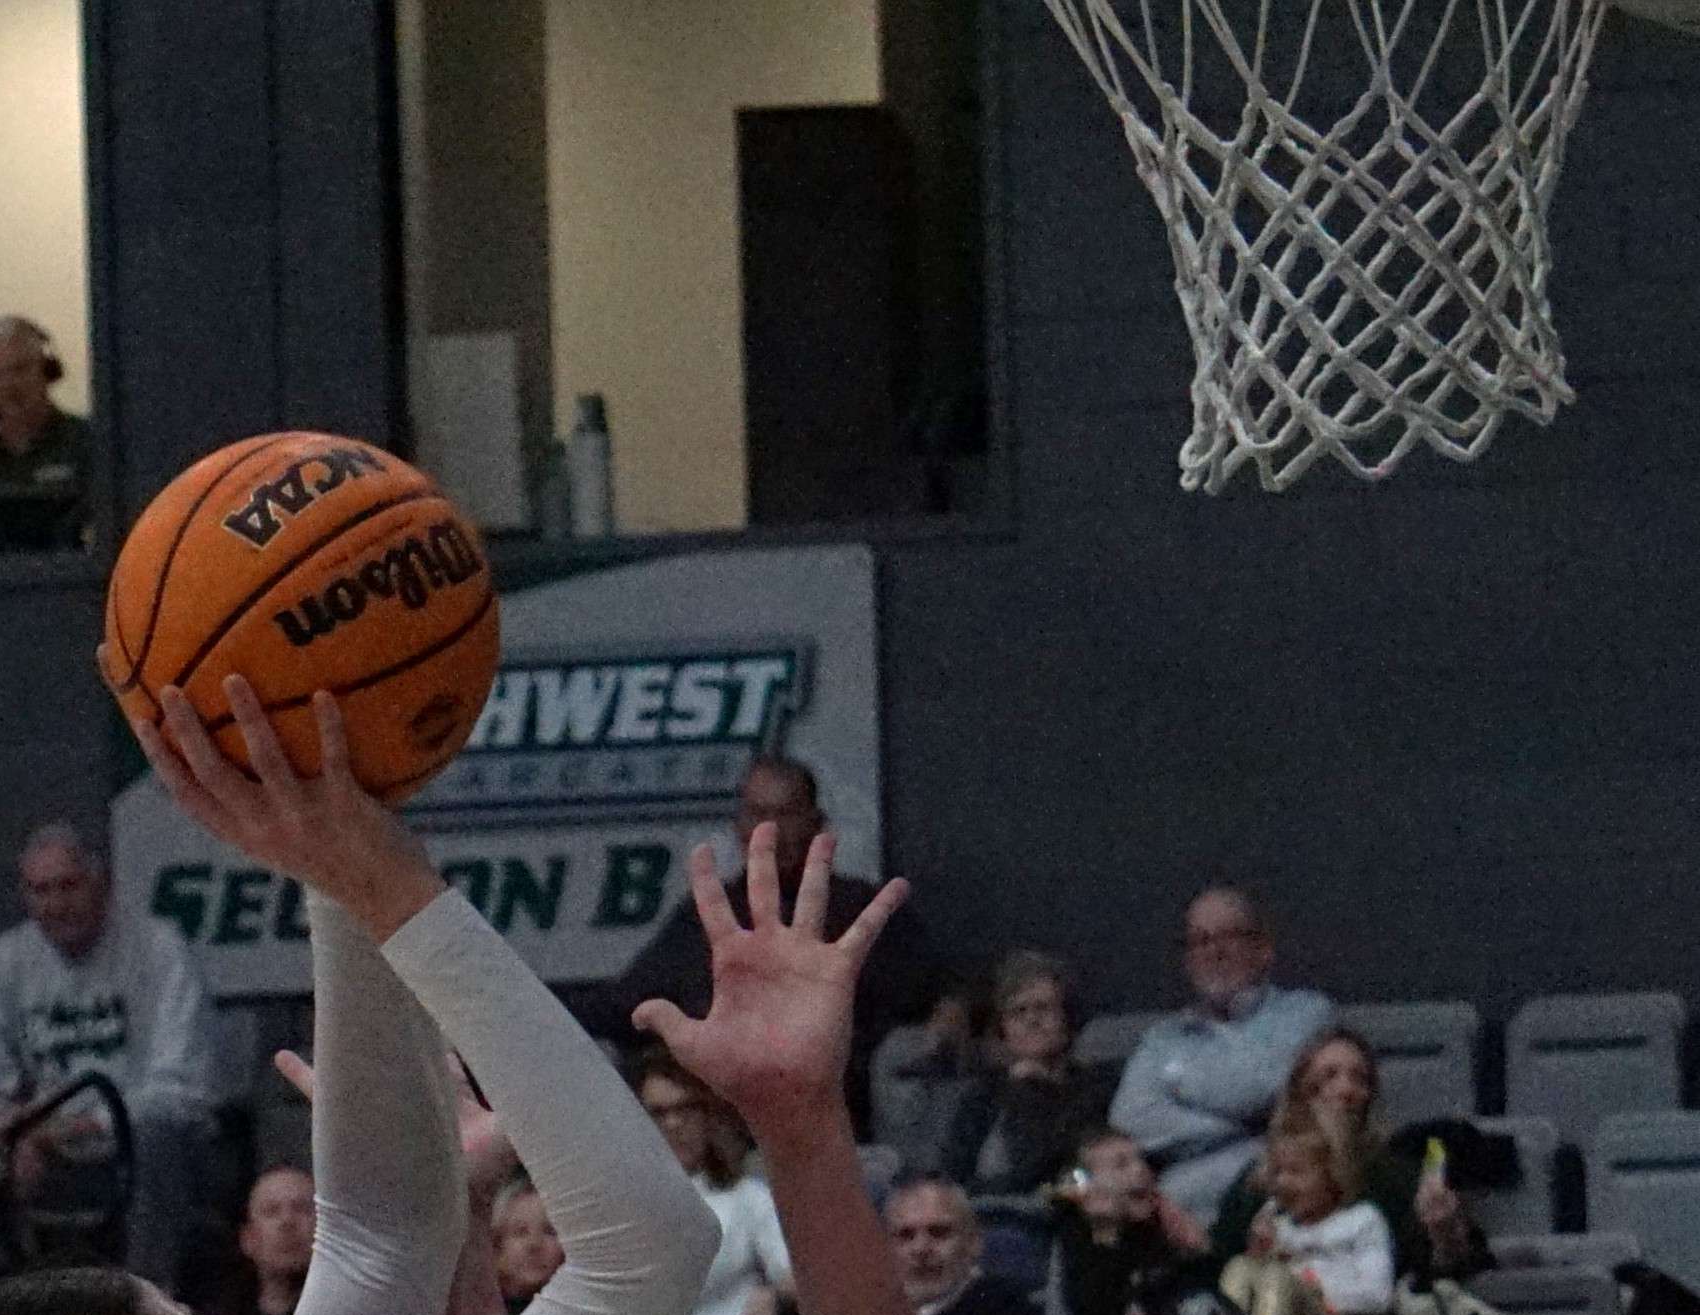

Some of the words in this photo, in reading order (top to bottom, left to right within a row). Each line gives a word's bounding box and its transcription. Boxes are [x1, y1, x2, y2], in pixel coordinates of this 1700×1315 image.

[222, 449, 387, 550] NCAA
[274, 521, 482, 646] Wilson
[463, 660, 788, 748] HWEST
[596, 842, 672, 928] B
